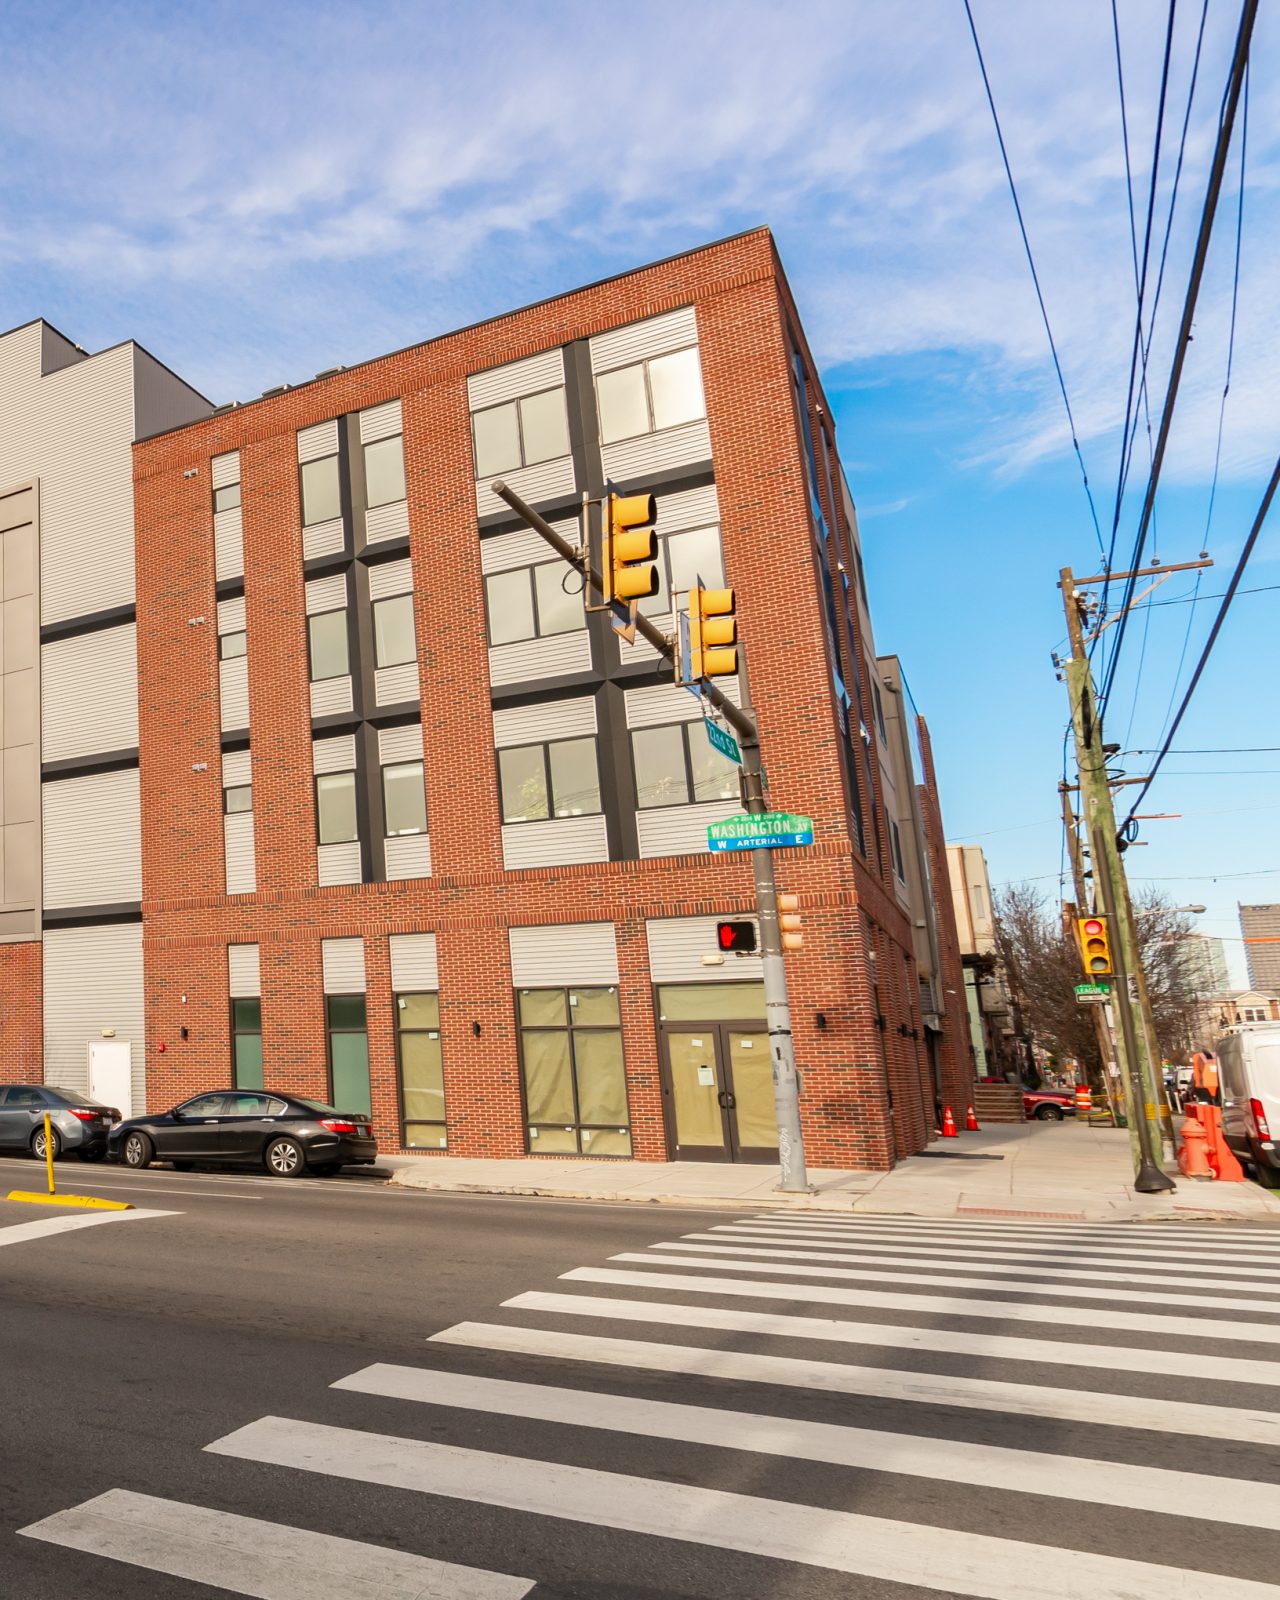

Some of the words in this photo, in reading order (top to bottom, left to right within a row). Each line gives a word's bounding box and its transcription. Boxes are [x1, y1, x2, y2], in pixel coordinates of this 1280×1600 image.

[711, 820, 791, 838] WASHINGTON
[717, 840, 728, 849] W
[736, 837, 783, 847] ARTERIAL
[795, 834, 804, 844] E
